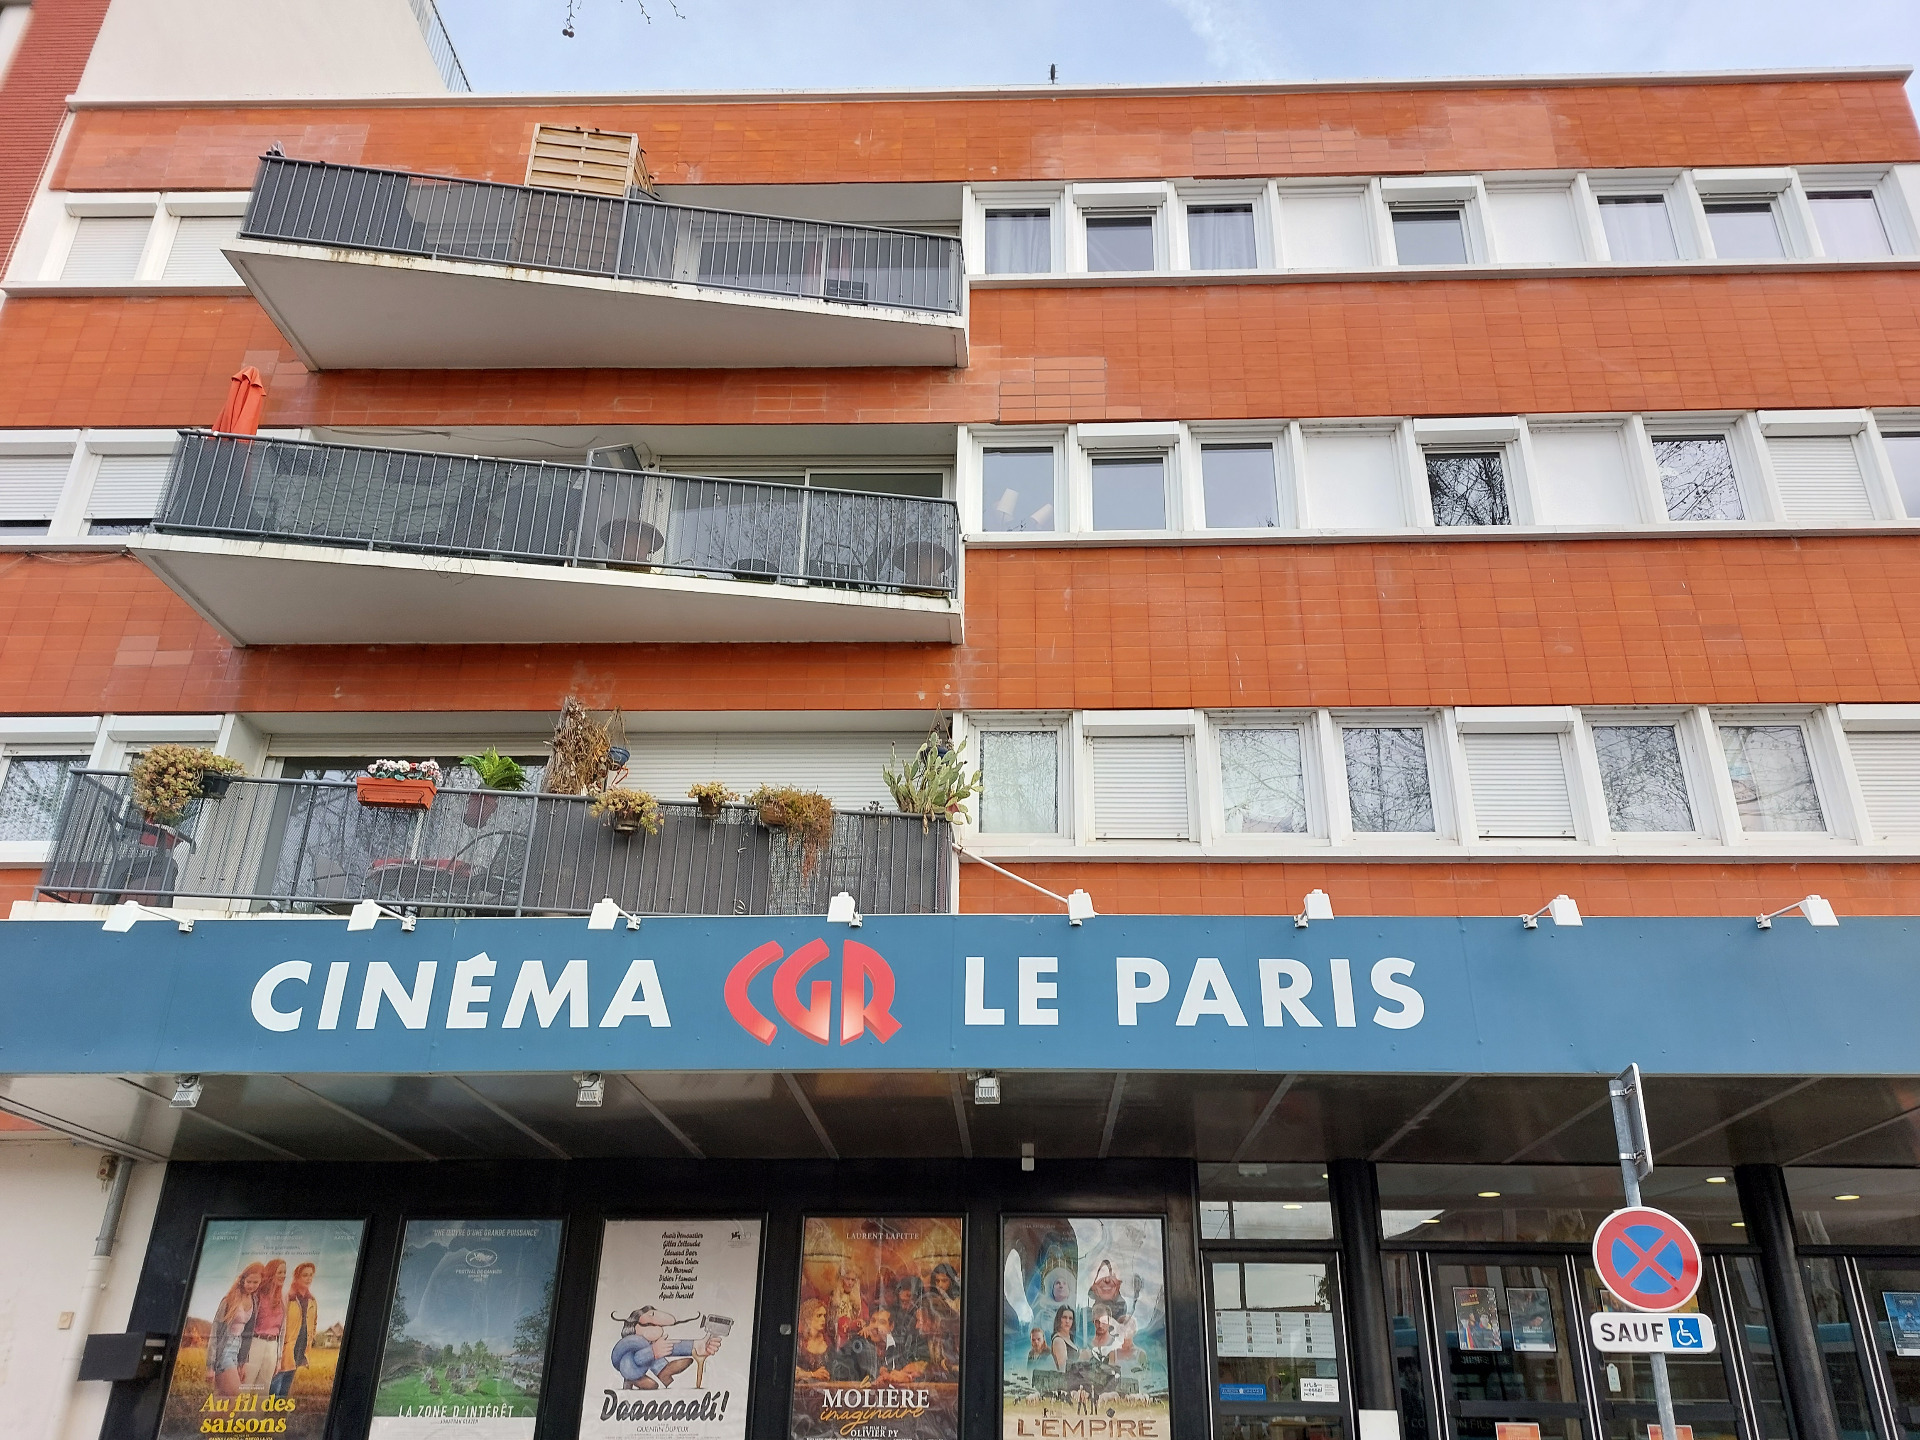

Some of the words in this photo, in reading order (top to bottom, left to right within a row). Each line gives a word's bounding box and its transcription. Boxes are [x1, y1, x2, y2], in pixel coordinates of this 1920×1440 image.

[251, 951, 672, 1032] CINÉMA
[724, 939, 903, 1047] CGR
[964, 956, 1059, 1026] LE
[1116, 956, 1425, 1030] PARIS
[484, 1229, 505, 1237] GRANDE
[846, 1232, 883, 1240] LAURENT
[885, 1232, 919, 1240] LAFITTE
[661, 1257, 684, 1266] Jonathan
[684, 1257, 699, 1265] Cohen
[661, 1282, 679, 1290] Romain
[680, 1282, 694, 1290] Duris
[1600, 1323, 1664, 1343] SAUF
[859, 1375, 873, 1389] le
[200, 1393, 230, 1412] Au
[232, 1393, 259, 1413] fil
[261, 1394, 296, 1413] des
[822, 1384, 930, 1409] MOLIÈRE
[398, 1405, 412, 1418] LA
[417, 1405, 448, 1418] ZONE
[453, 1403, 515, 1418] D'INTÉRÊT
[200, 1412, 287, 1433] saisons
[820, 1405, 925, 1437] imaginaire
[1017, 1415, 1159, 1438] L'EMPIRE
[636, 1425, 664, 1433] QUENTIN
[850, 1429, 886, 1437] OLIVIER
[887, 1429, 899, 1438] PY
